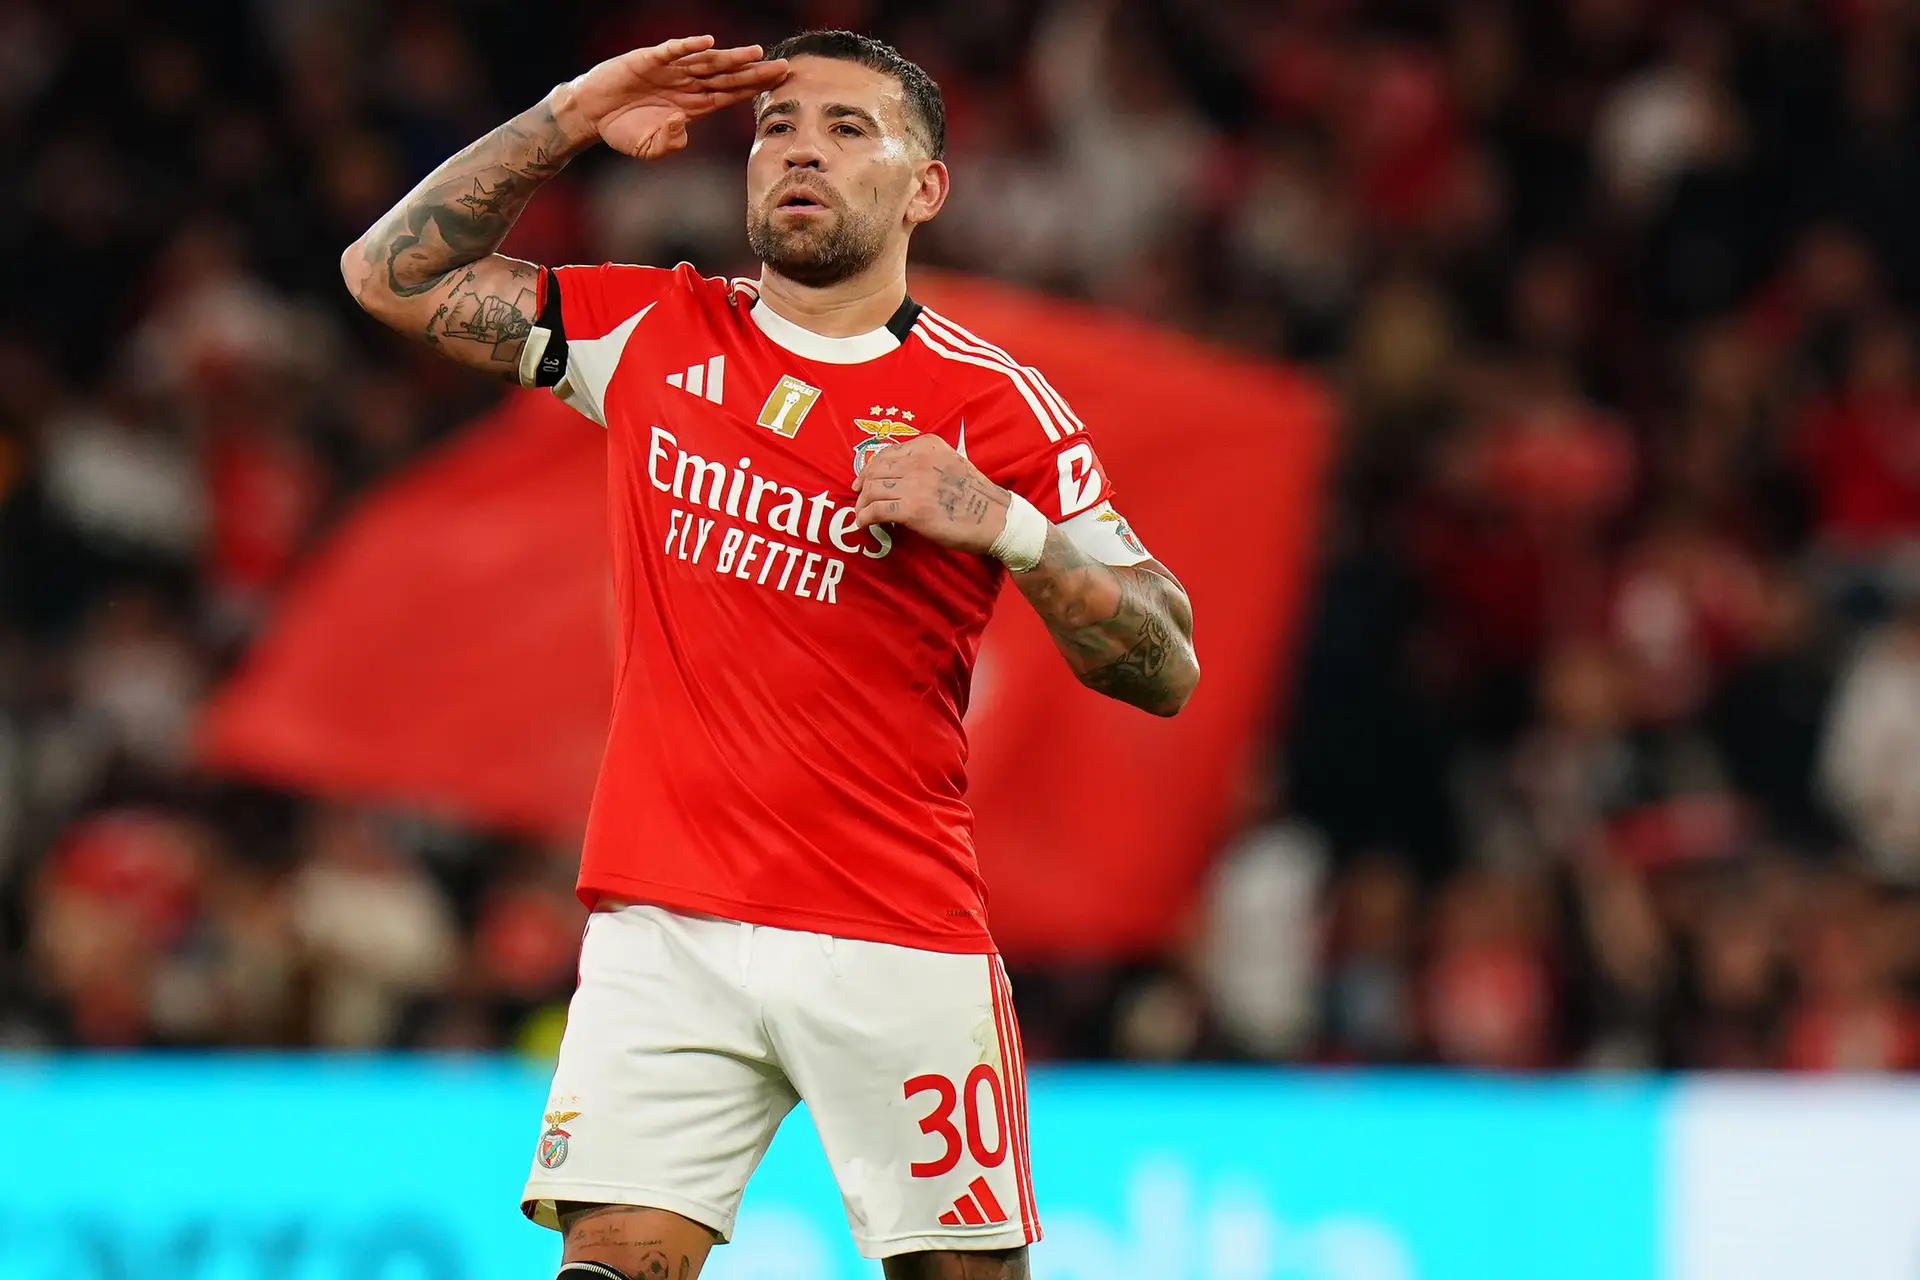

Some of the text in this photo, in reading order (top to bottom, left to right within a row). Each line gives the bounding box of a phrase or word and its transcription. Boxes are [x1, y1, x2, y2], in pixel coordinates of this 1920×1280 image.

[542, 357, 560, 373] 30
[648, 425, 894, 559] Emirates
[665, 508, 845, 604] FLY BETTER
[903, 1063, 1008, 1178] 30
